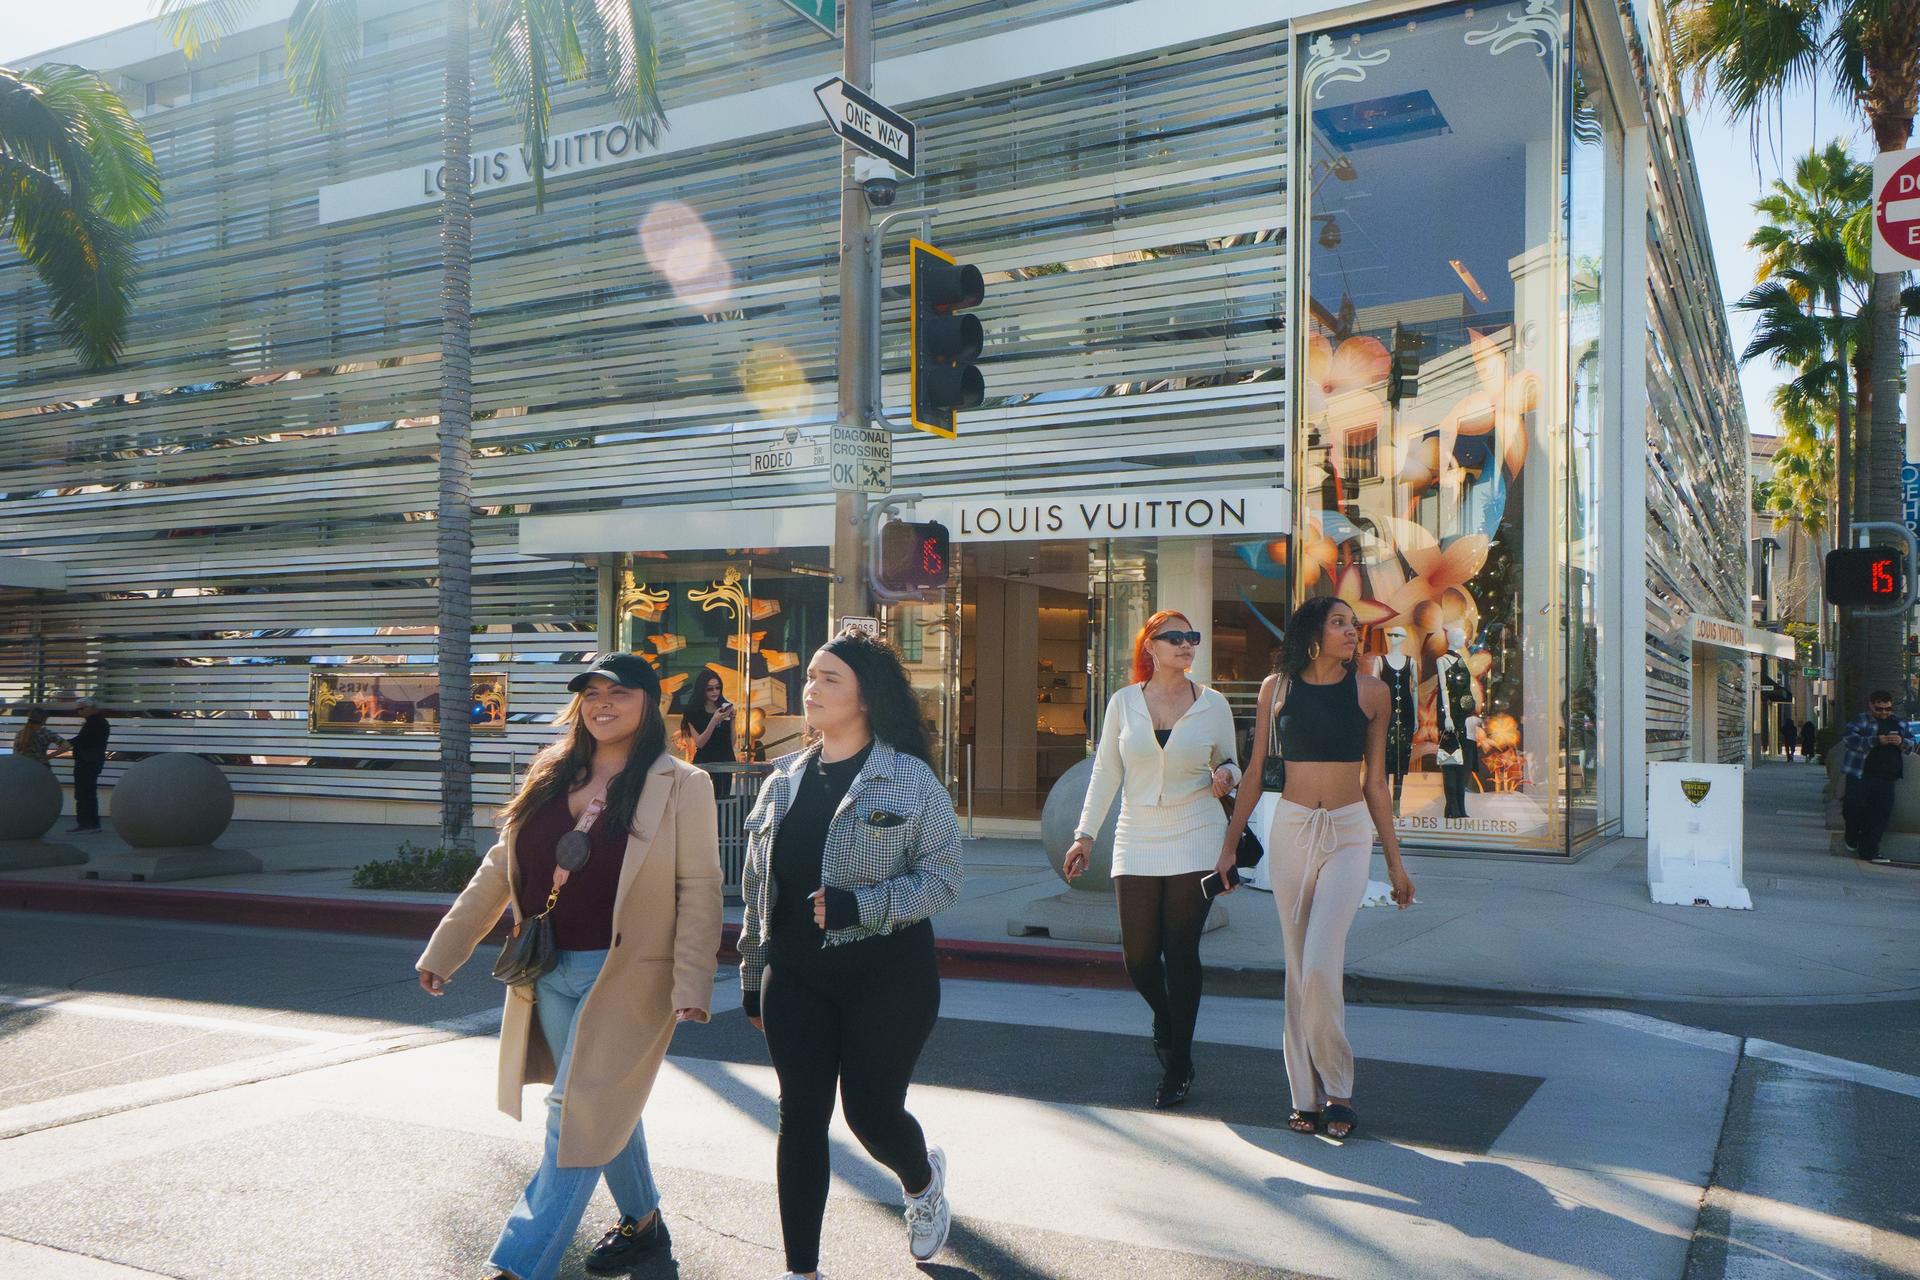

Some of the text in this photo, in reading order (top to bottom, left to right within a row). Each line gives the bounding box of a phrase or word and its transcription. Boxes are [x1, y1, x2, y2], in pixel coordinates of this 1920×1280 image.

[846, 102, 903, 151] ONE WAY
[834, 428, 888, 444] DIAGONAL
[755, 452, 792, 470] RODEO
[833, 443, 889, 458] CROSSING
[833, 463, 854, 484] OK
[961, 498, 1245, 534] LOUIS VUITTON
[1872, 560, 1893, 593] 15
[1696, 619, 1744, 646] LOUIS VUITTON
[1412, 816, 1438, 829] DES
